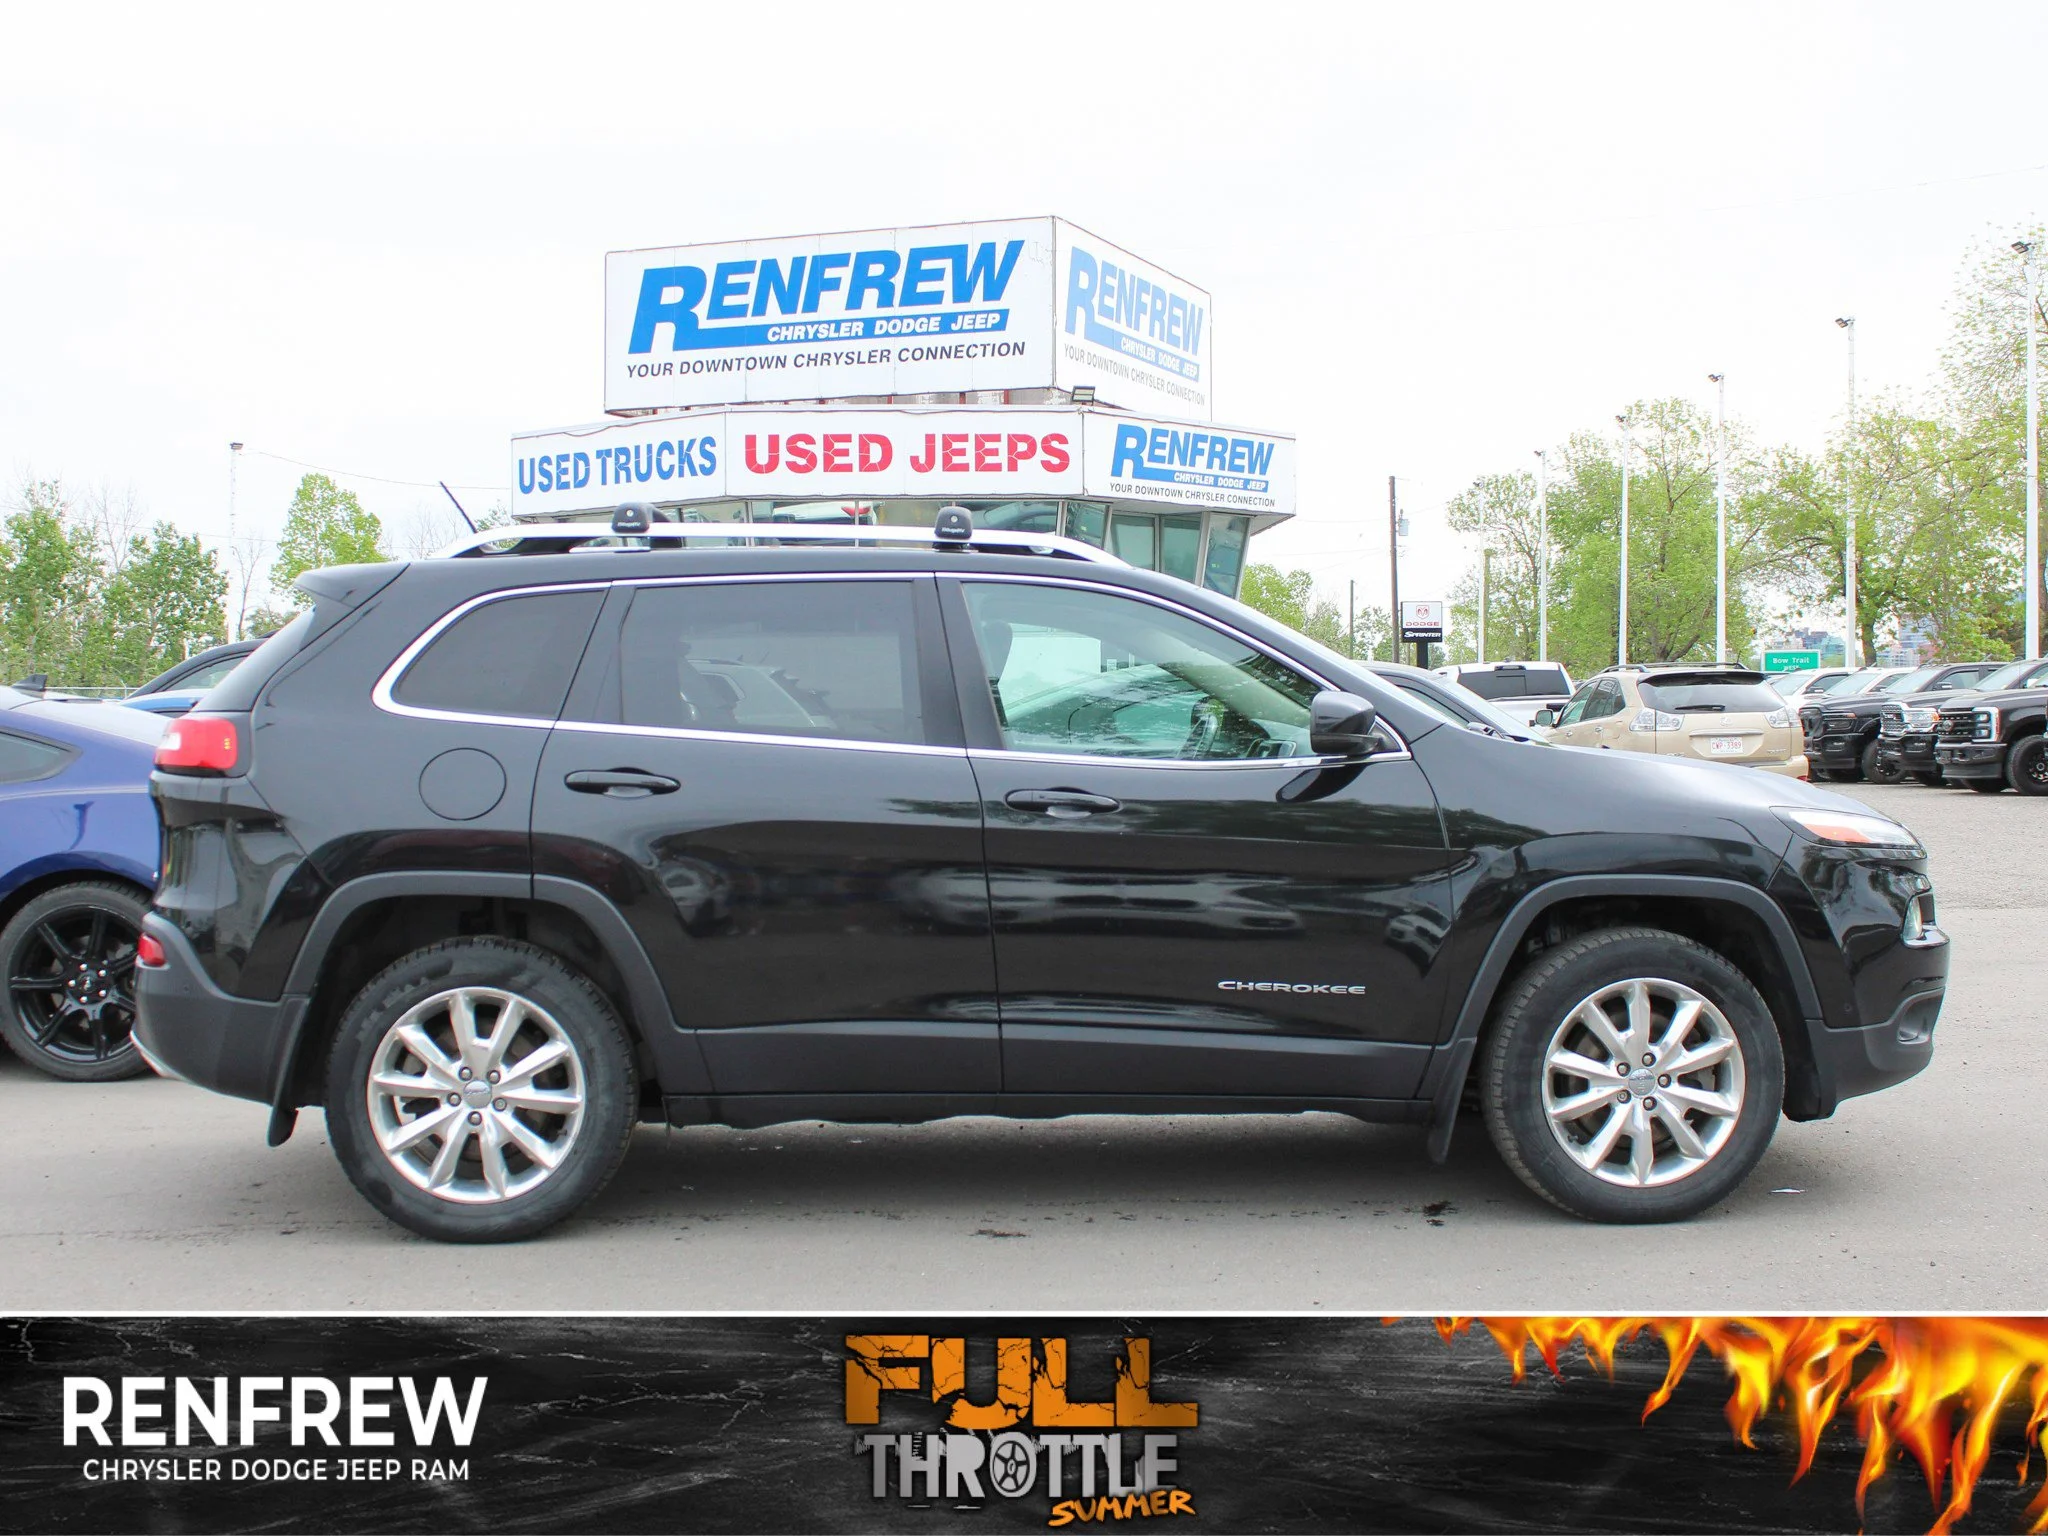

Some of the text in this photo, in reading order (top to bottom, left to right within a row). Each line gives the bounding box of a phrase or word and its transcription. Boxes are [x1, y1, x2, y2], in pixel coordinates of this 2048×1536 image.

[628, 240, 1025, 354] RENFREW
[1065, 246, 1204, 357] RENFREW
[766, 312, 1001, 342] CHRYSLER DODGE JEEP
[627, 341, 1026, 378] YOUR DOWNTOWN CHRYSLER CONNECTION
[1064, 343, 1206, 406] YOUR DOWNTOWN CHRYSLER CONNECTION
[1121, 336, 1198, 378] CHRYSLER DODGE JEEP
[518, 435, 717, 494] USED TRUCKS
[745, 433, 1071, 475] USED JEEPS
[1110, 423, 1275, 477] RENFREW
[1109, 482, 1275, 507] YOUR DOWNTOWN CHRYSLER CONNECTION
[1173, 471, 1266, 491] CHRYSLER DODGE JEEP
[1217, 981, 1366, 995] CHEROKEE
